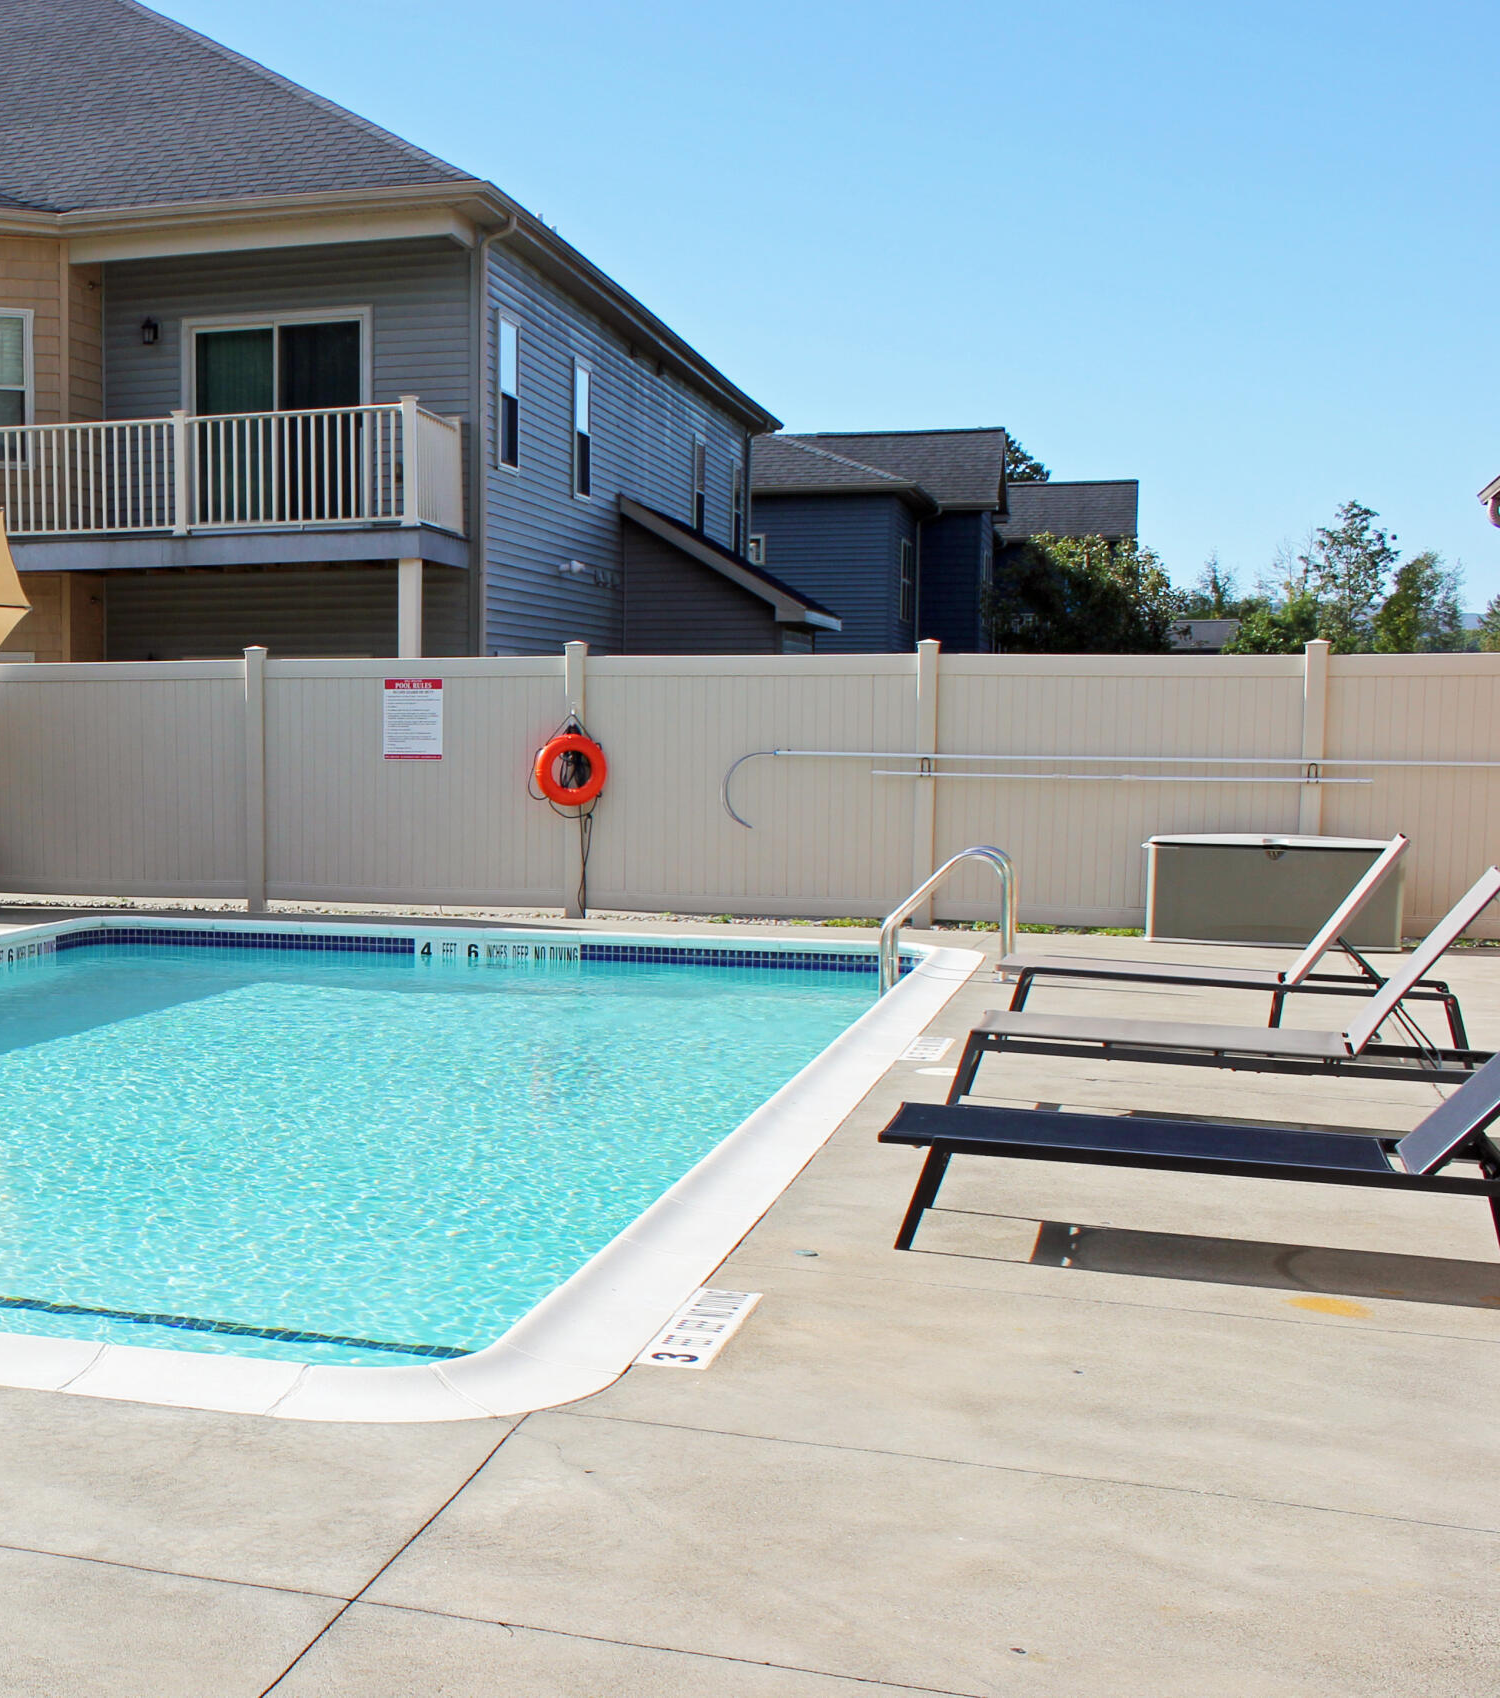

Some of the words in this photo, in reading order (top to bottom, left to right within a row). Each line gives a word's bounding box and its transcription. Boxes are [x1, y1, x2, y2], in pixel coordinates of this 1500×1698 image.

[8, 948, 14, 962] 6
[420, 942, 432, 956] 4
[467, 944, 479, 958] 6
[534, 946, 546, 960] NO
[549, 946, 579, 961] DIVING
[651, 1352, 699, 1363] 3
